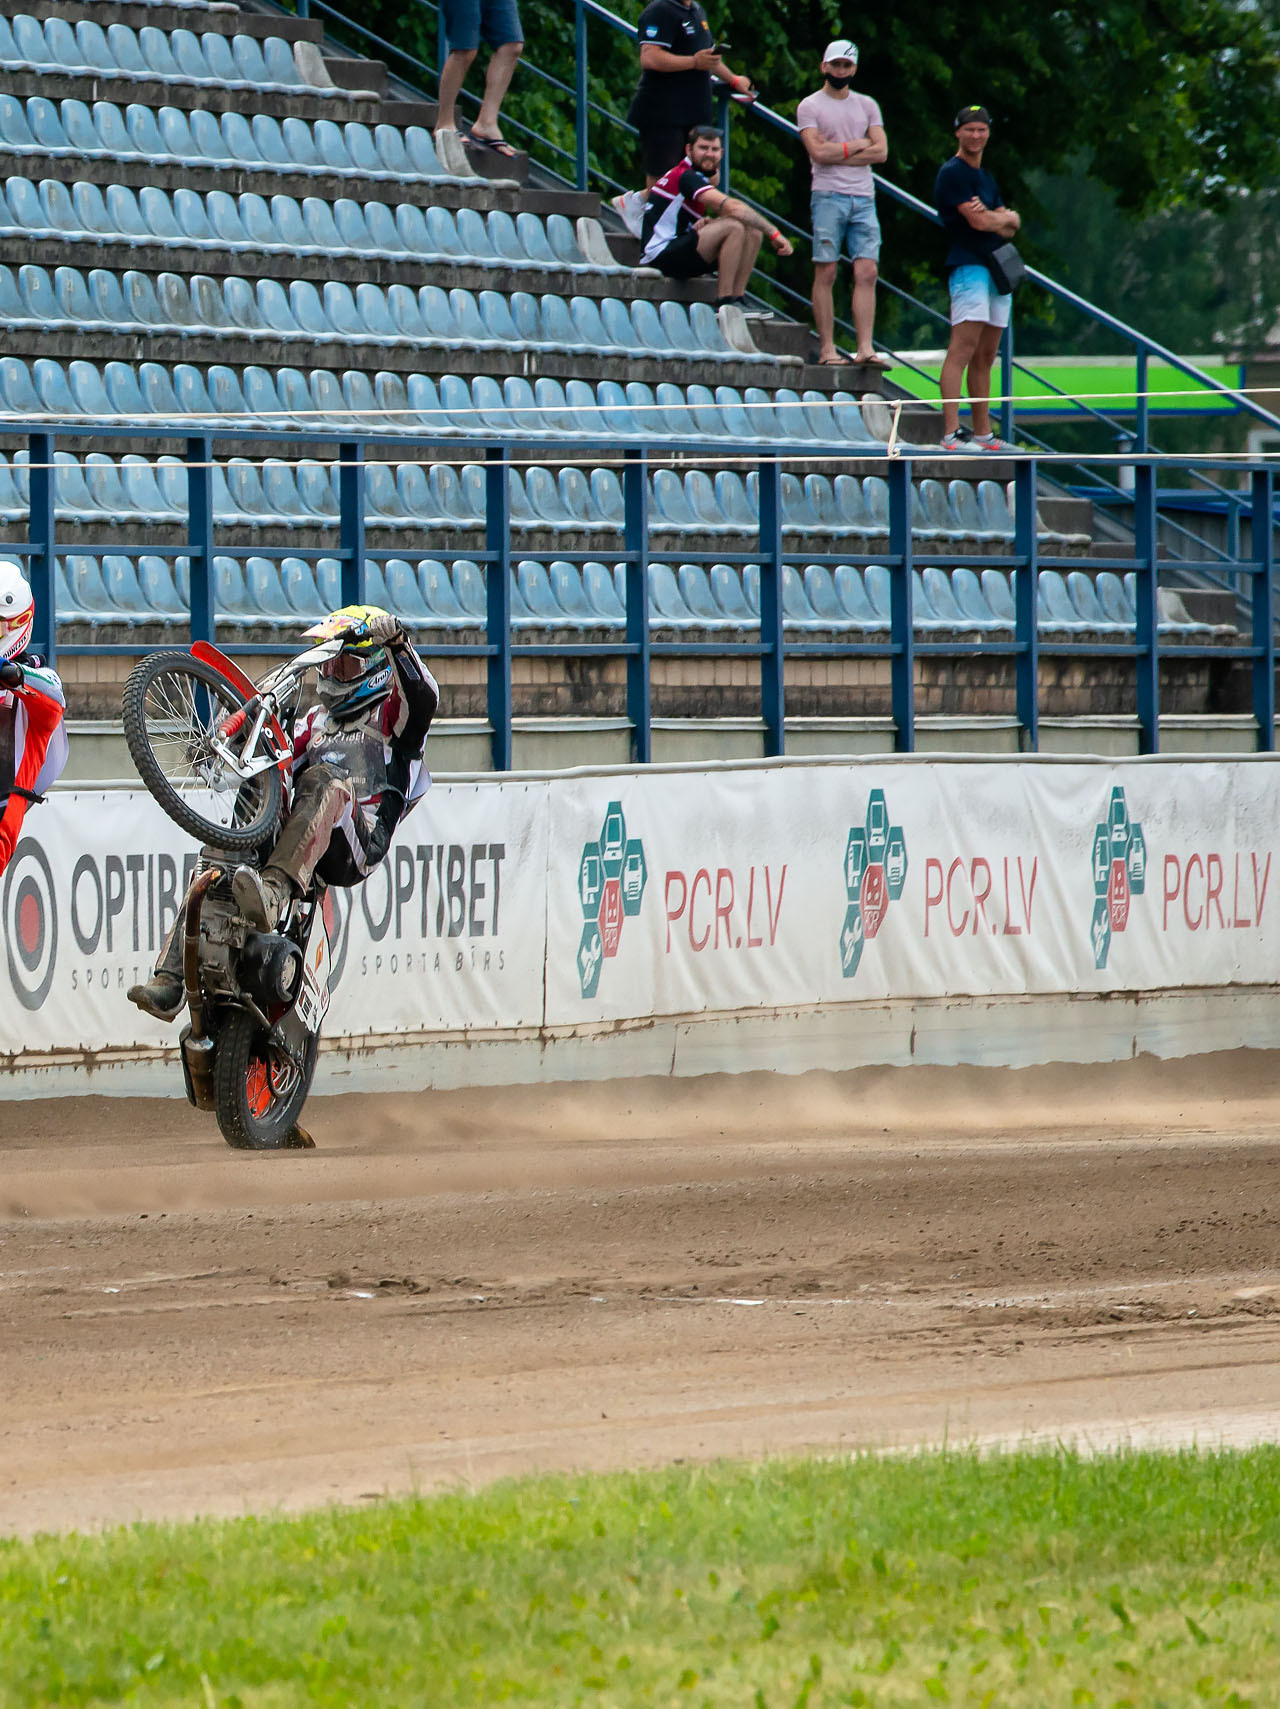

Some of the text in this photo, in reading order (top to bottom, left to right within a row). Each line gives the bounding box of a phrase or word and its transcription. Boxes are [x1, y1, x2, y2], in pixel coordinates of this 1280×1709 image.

[71, 853, 198, 955] OPTIB
[361, 843, 505, 942] OPTIBET
[665, 864, 787, 953] PCR.LV
[924, 856, 1037, 938] PCR.LV
[1163, 851, 1272, 931] PCR.LV
[72, 966, 154, 991] SPORT
[361, 952, 440, 976] SPORTA
